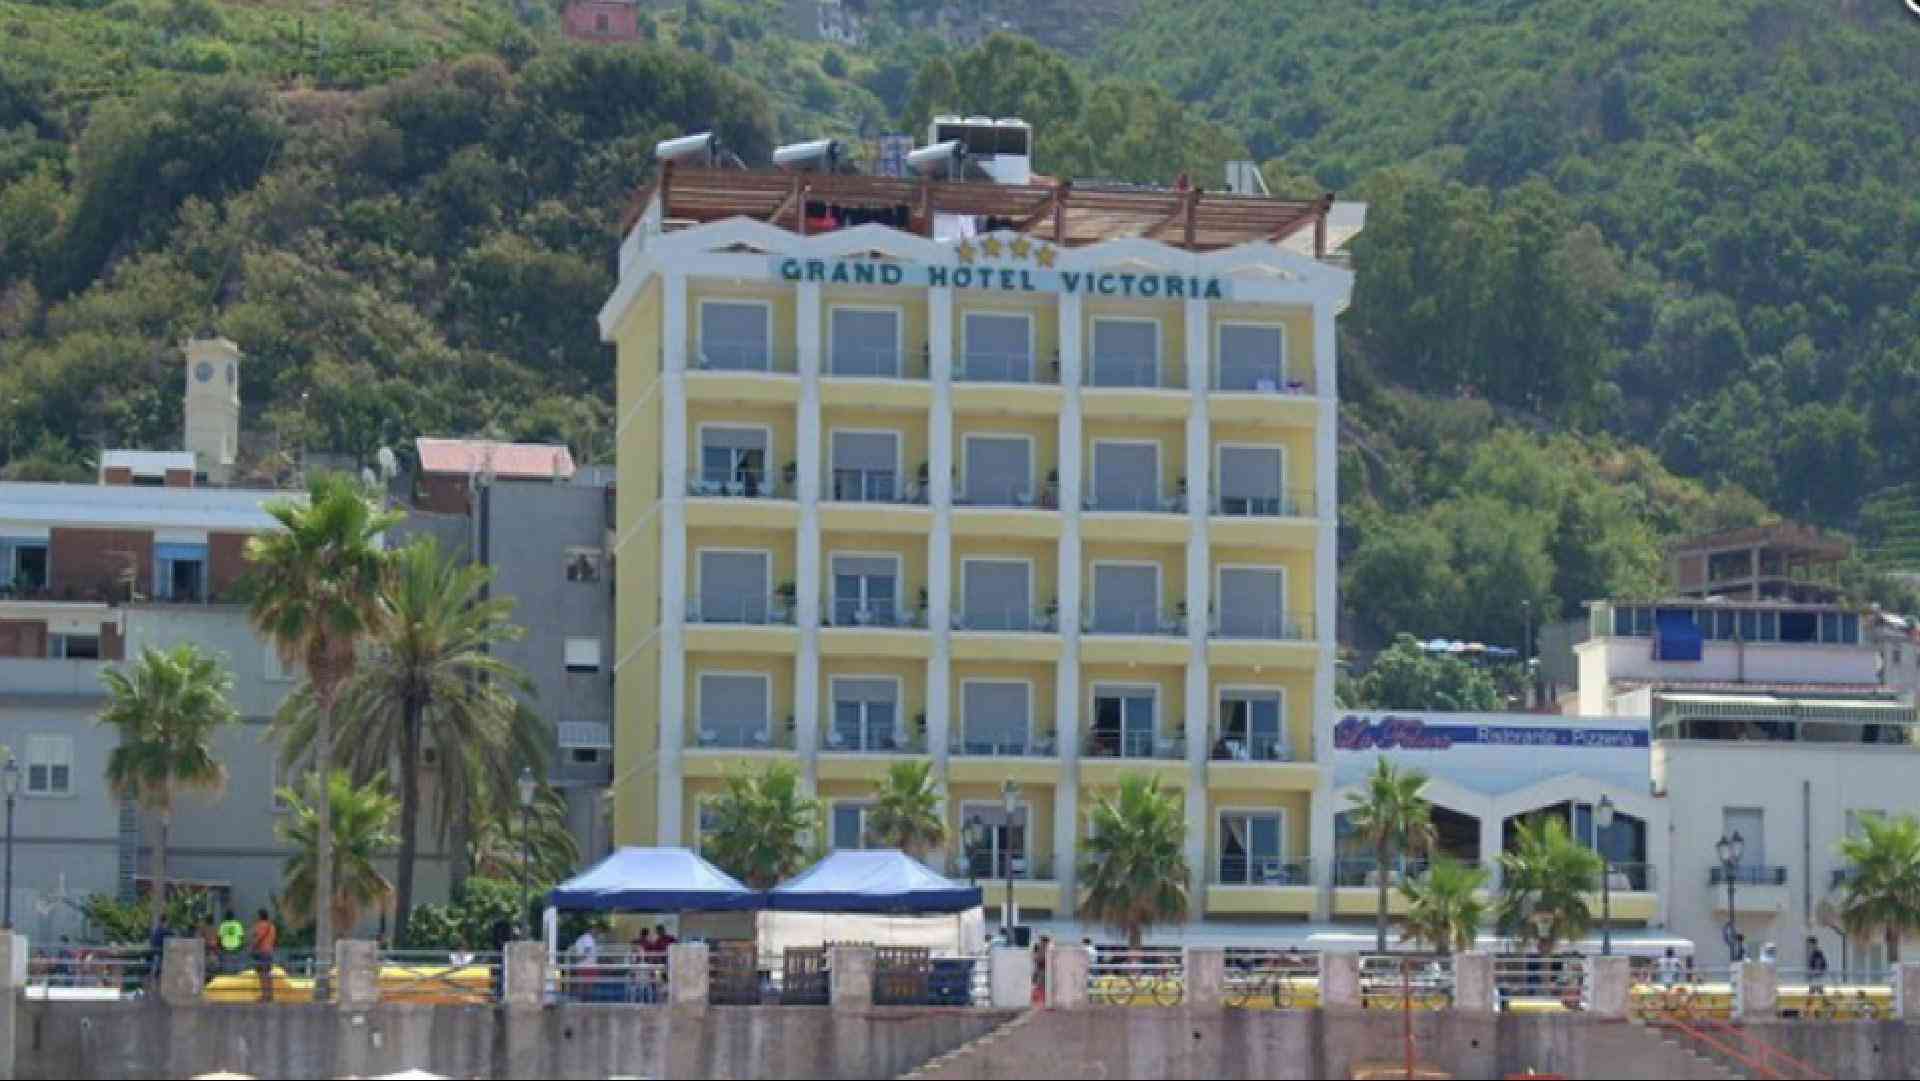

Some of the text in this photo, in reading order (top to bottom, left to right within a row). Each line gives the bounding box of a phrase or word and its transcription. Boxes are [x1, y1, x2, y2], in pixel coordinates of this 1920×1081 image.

[780, 258, 1223, 300] GRAND HOTEL VICTORIA
